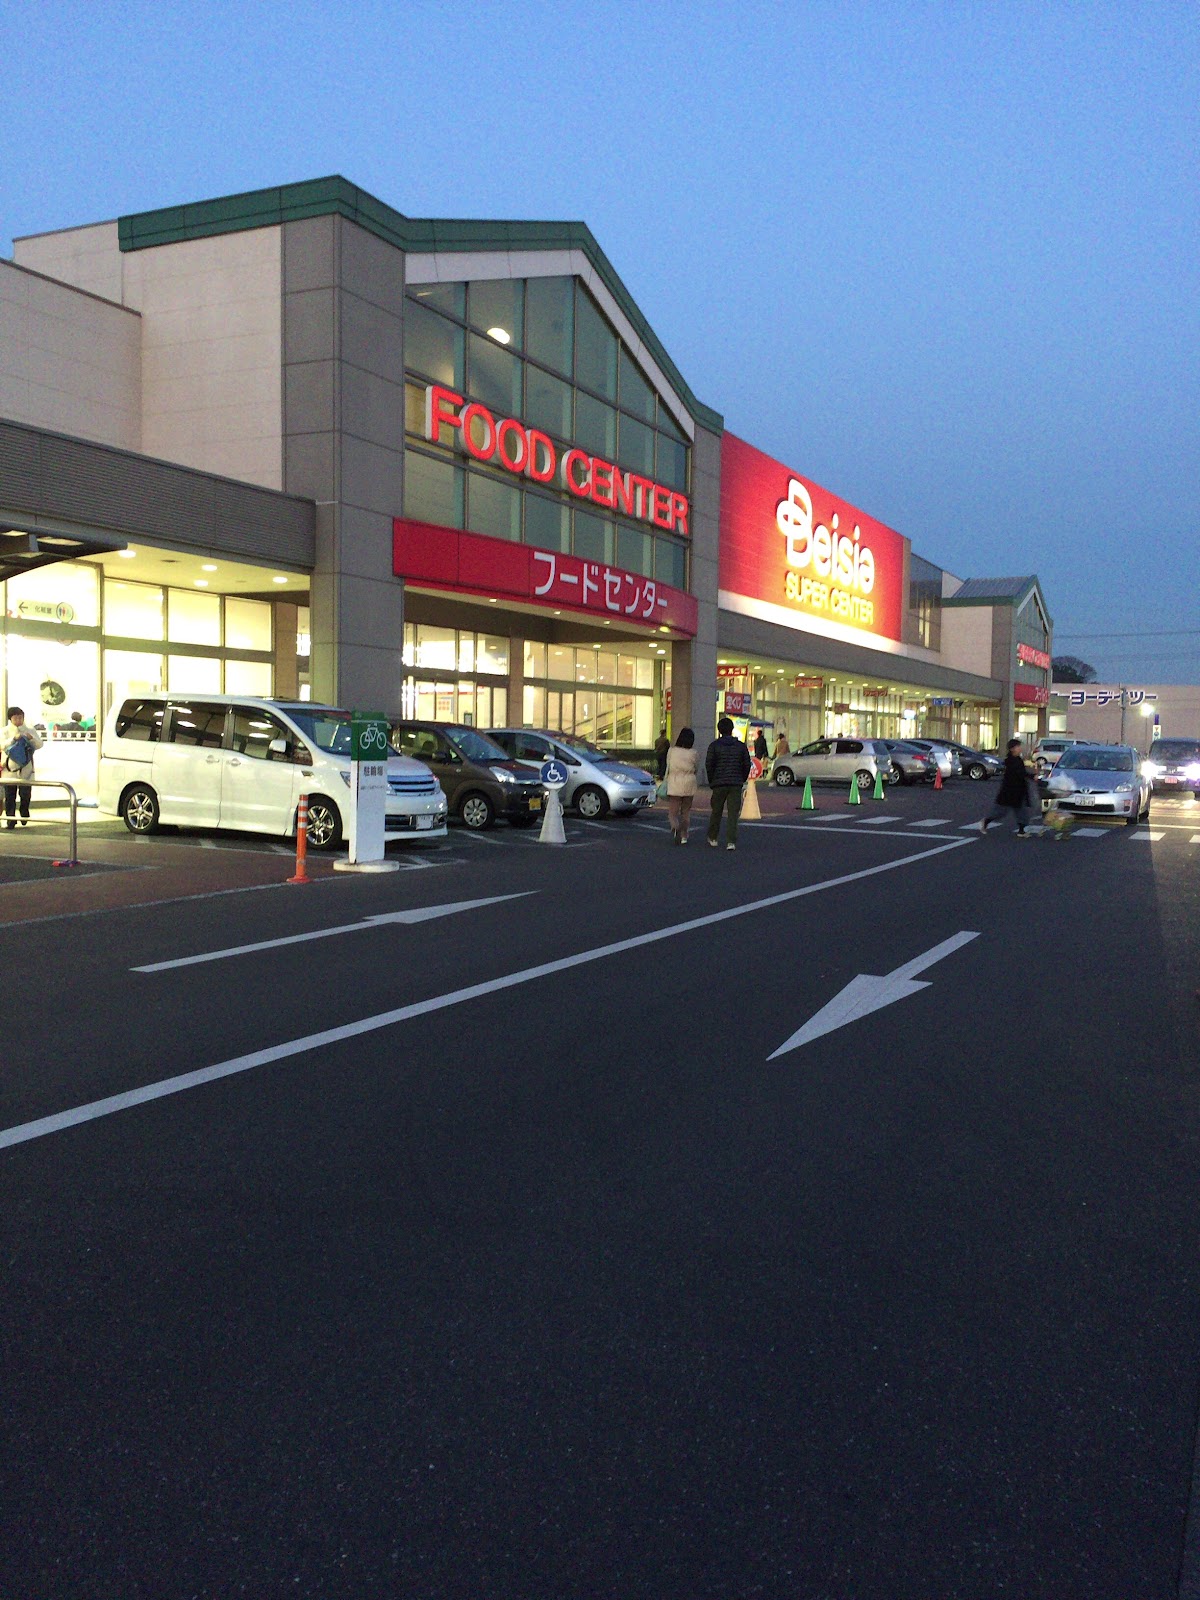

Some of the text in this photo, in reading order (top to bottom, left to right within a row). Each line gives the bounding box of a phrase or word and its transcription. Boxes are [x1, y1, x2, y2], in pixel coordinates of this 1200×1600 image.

[425, 385, 690, 535] FOOD CENTER
[776, 477, 875, 595] Beisia
[534, 551, 668, 618] フードセンター
[785, 571, 874, 626] SUPER CENTER
